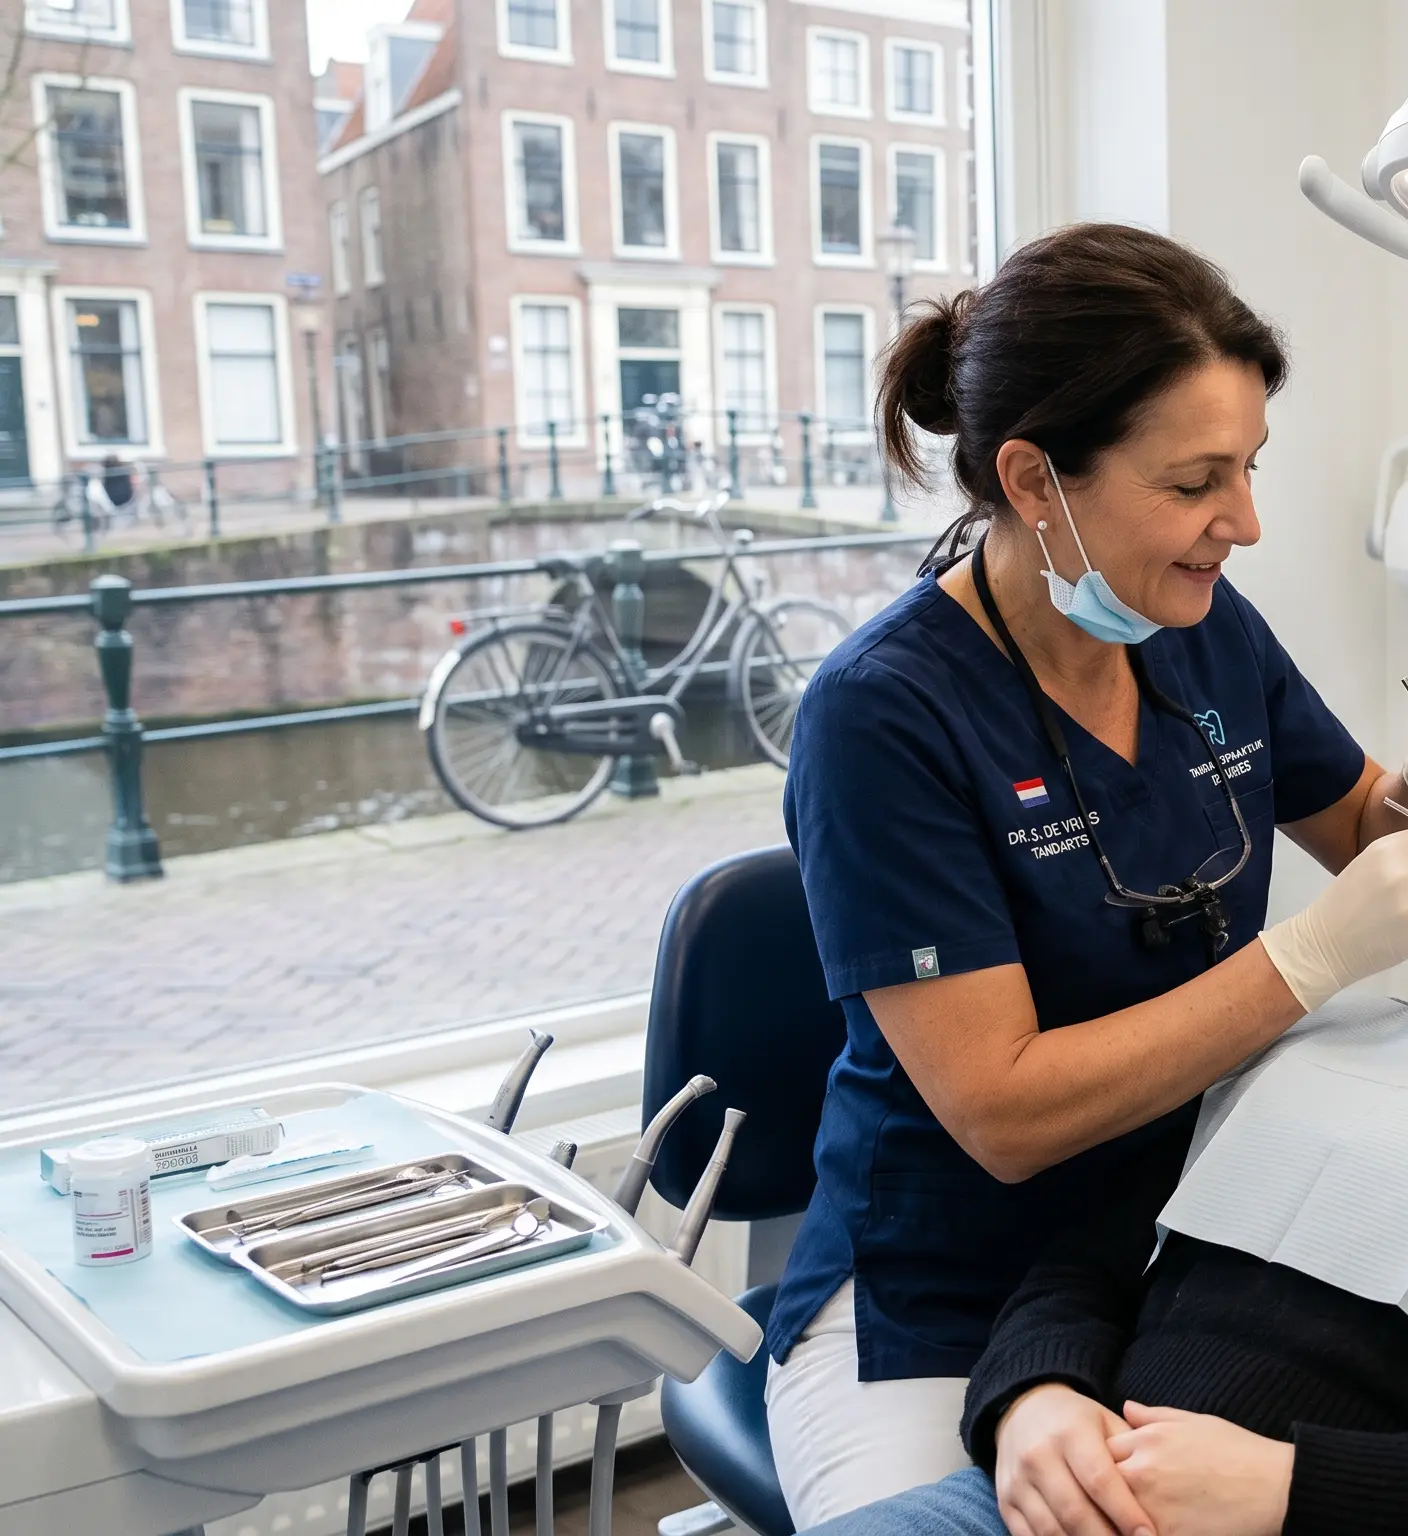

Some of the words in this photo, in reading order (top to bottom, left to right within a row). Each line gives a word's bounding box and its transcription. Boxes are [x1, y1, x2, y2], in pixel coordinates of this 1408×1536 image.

[1043, 822, 1061, 838] DE
[1061, 811, 1100, 833] VRIS
[1031, 834, 1090, 860] TANDARTS
